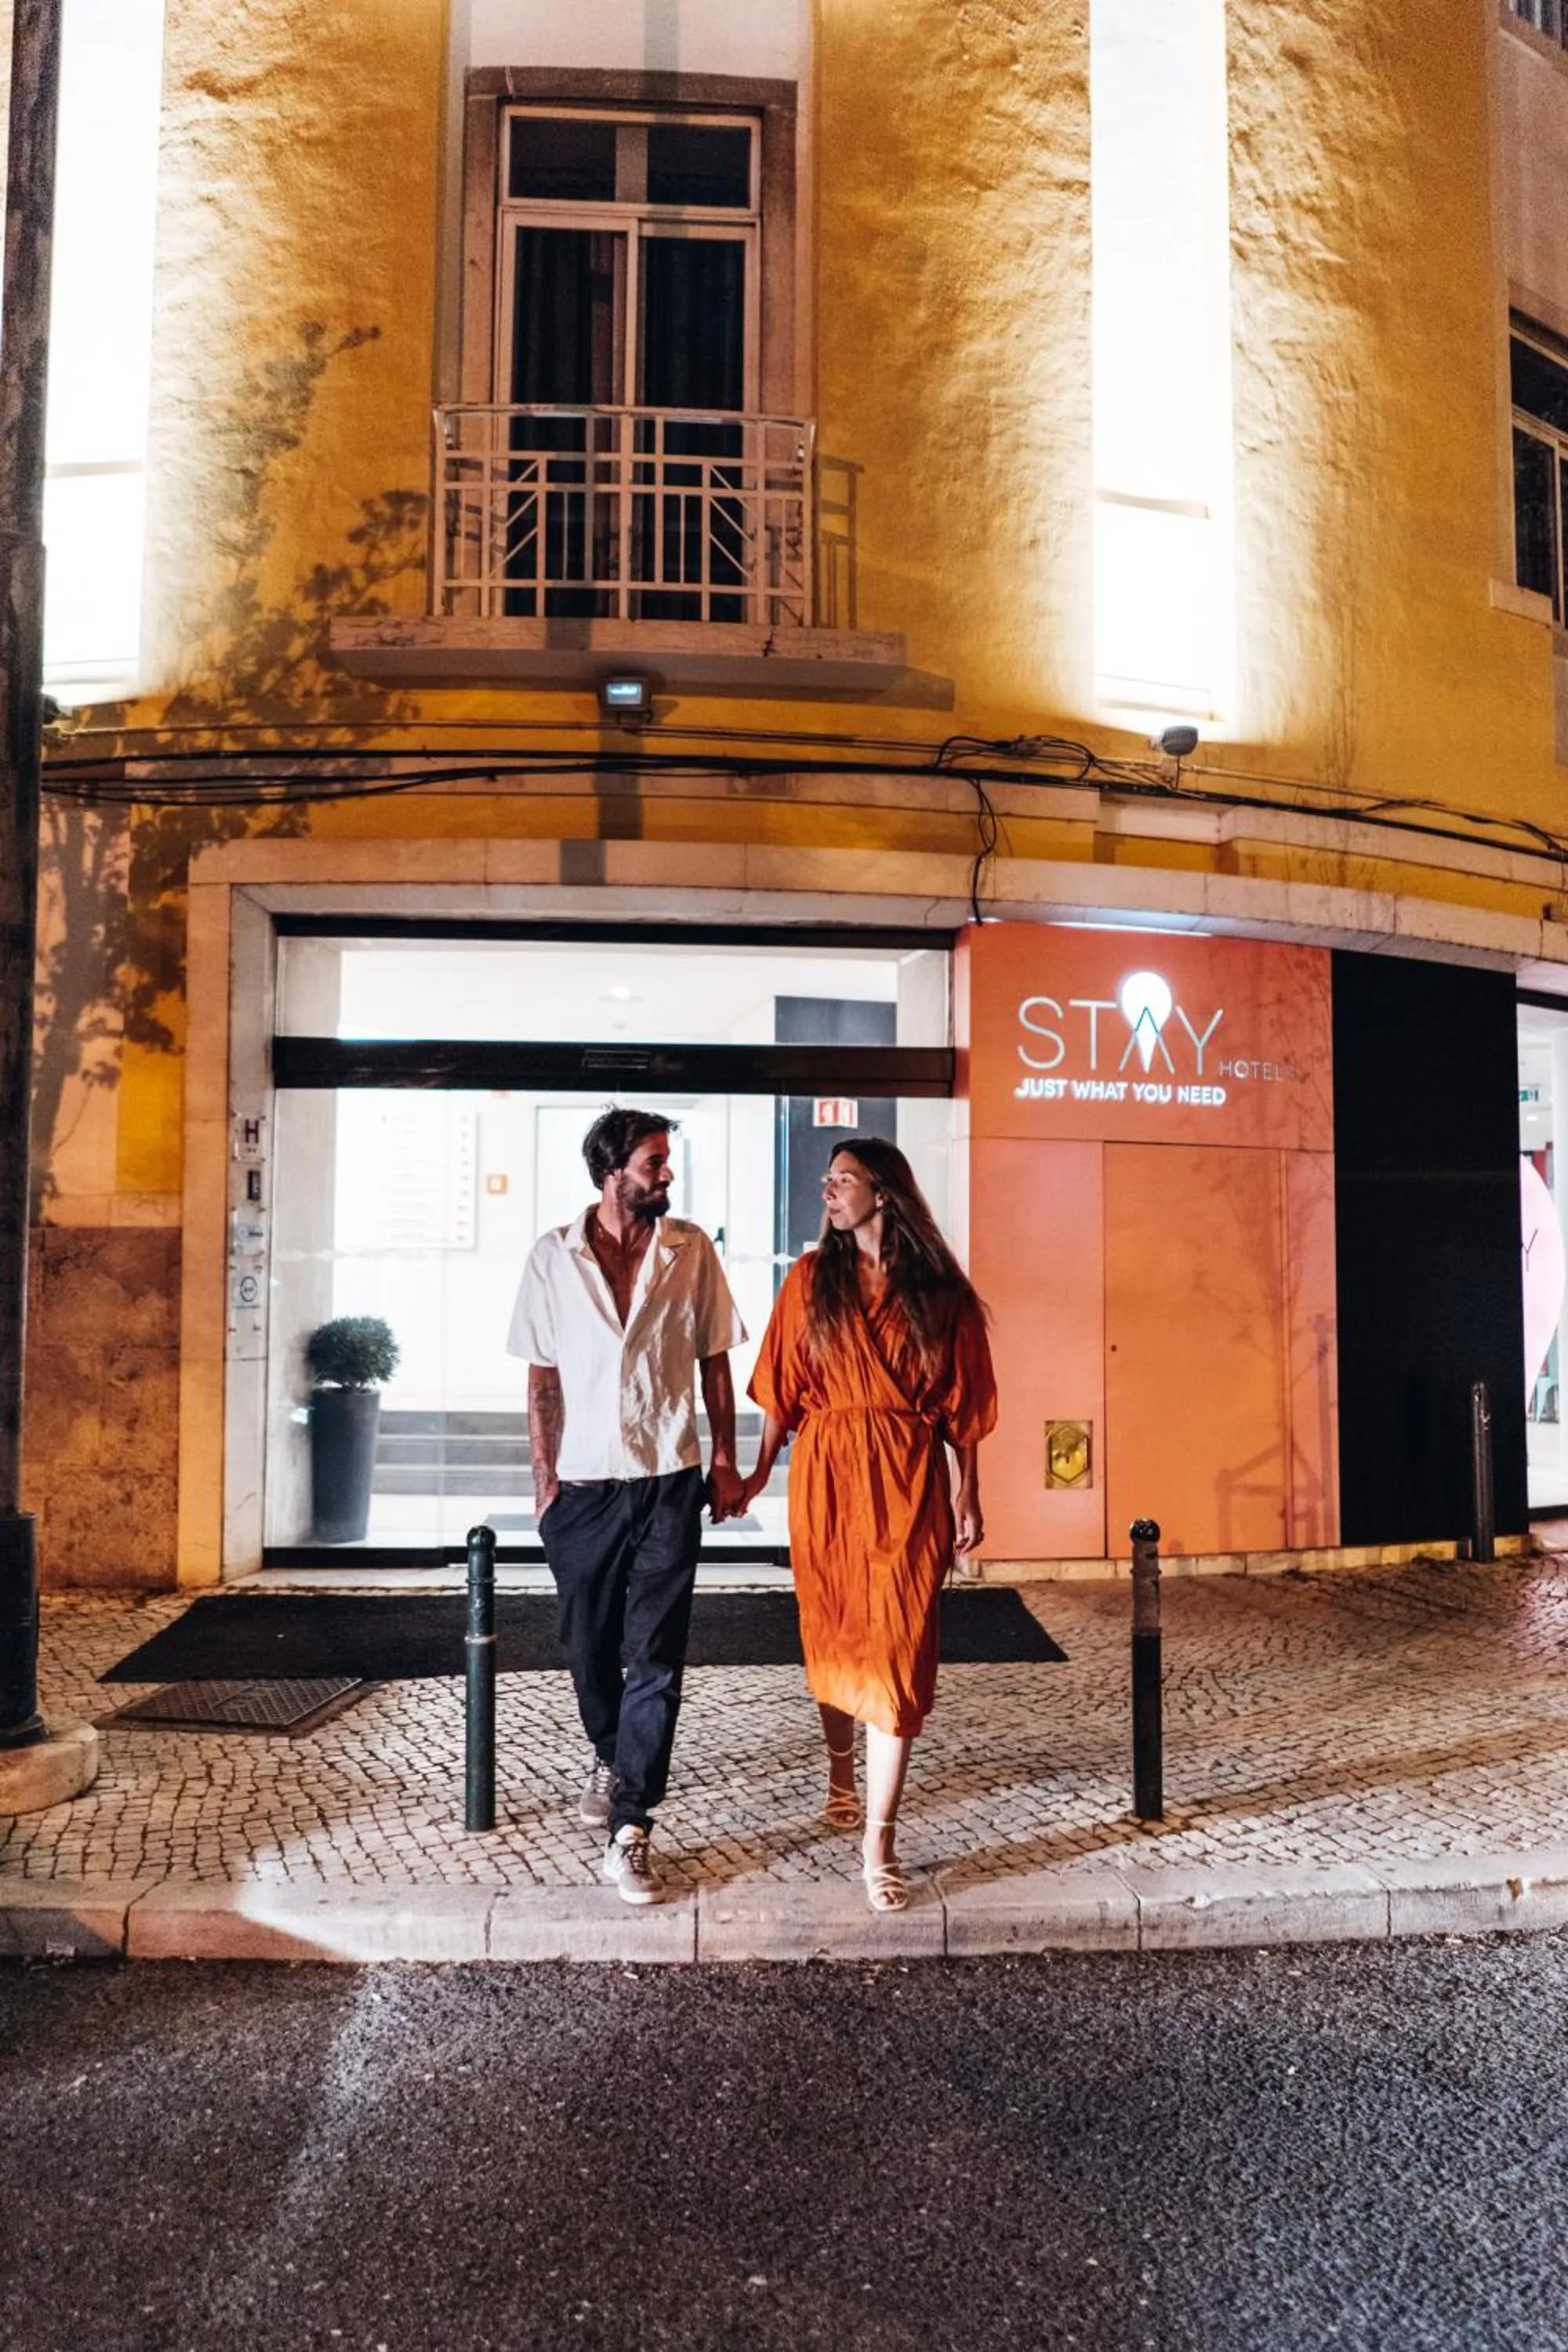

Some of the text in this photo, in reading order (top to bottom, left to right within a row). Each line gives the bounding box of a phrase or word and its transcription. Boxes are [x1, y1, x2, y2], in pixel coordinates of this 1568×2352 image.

[1018, 996, 1224, 1076] STAY
[1014, 1078, 1227, 1107] JUST WHAT YOU NEED
[245, 1119, 260, 1144] H
